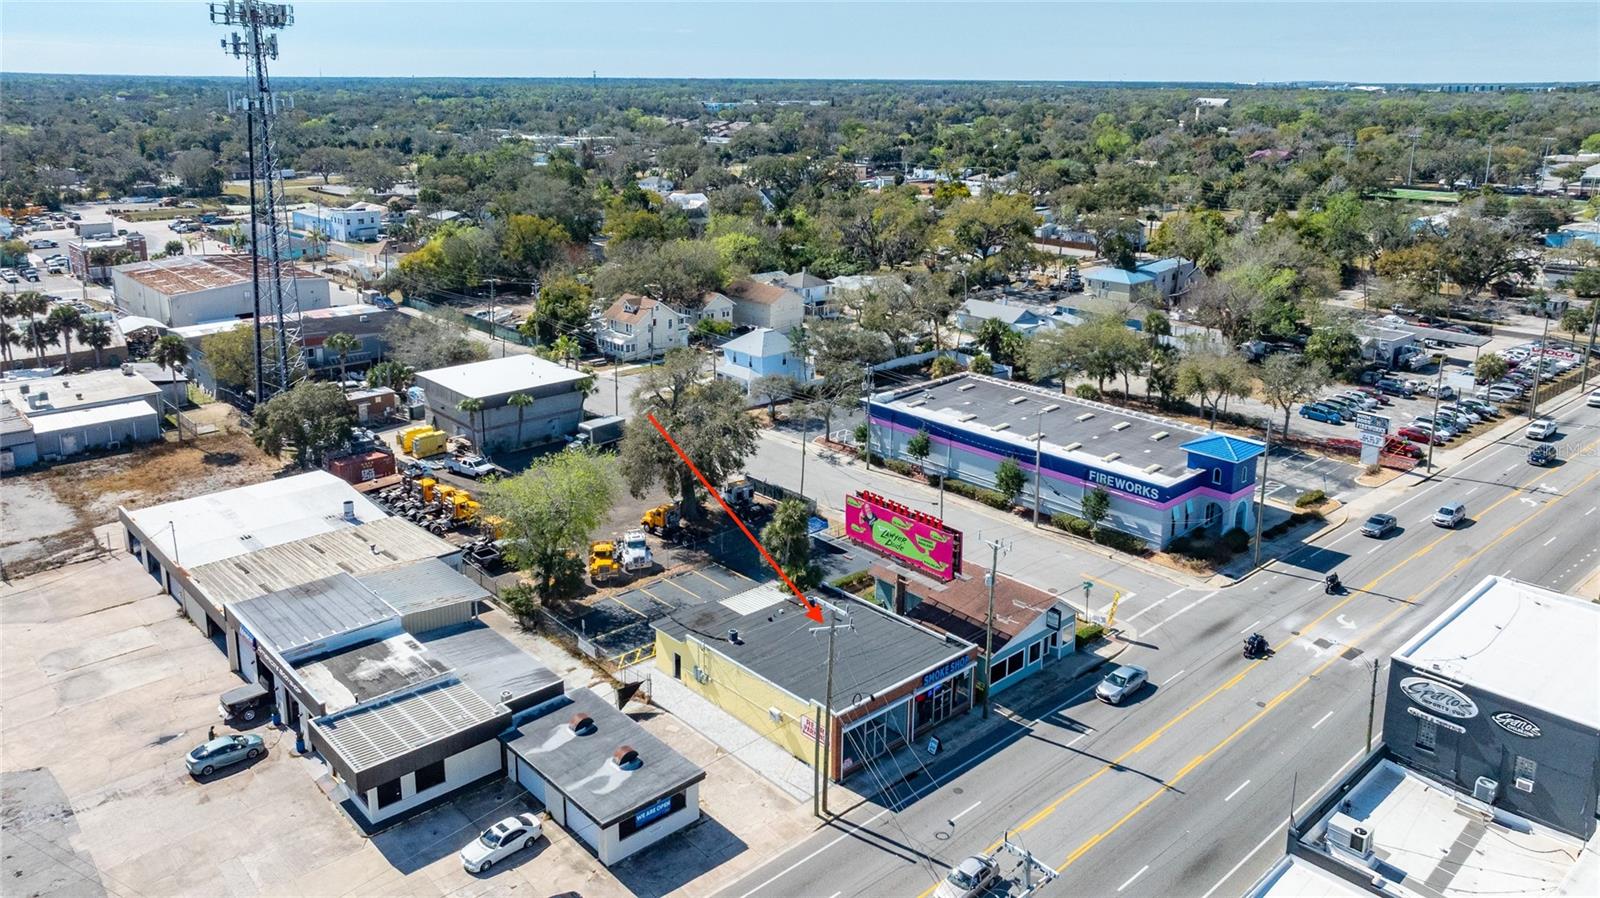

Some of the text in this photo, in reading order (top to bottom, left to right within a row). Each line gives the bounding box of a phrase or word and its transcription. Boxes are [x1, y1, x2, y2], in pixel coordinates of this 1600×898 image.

[1088, 470, 1159, 500] FIREWORKS
[923, 655, 970, 686] SMOKE SHOP
[636, 812, 646, 821] WE
[646, 808, 656, 817] ARE
[656, 800, 671, 812] OPEN
